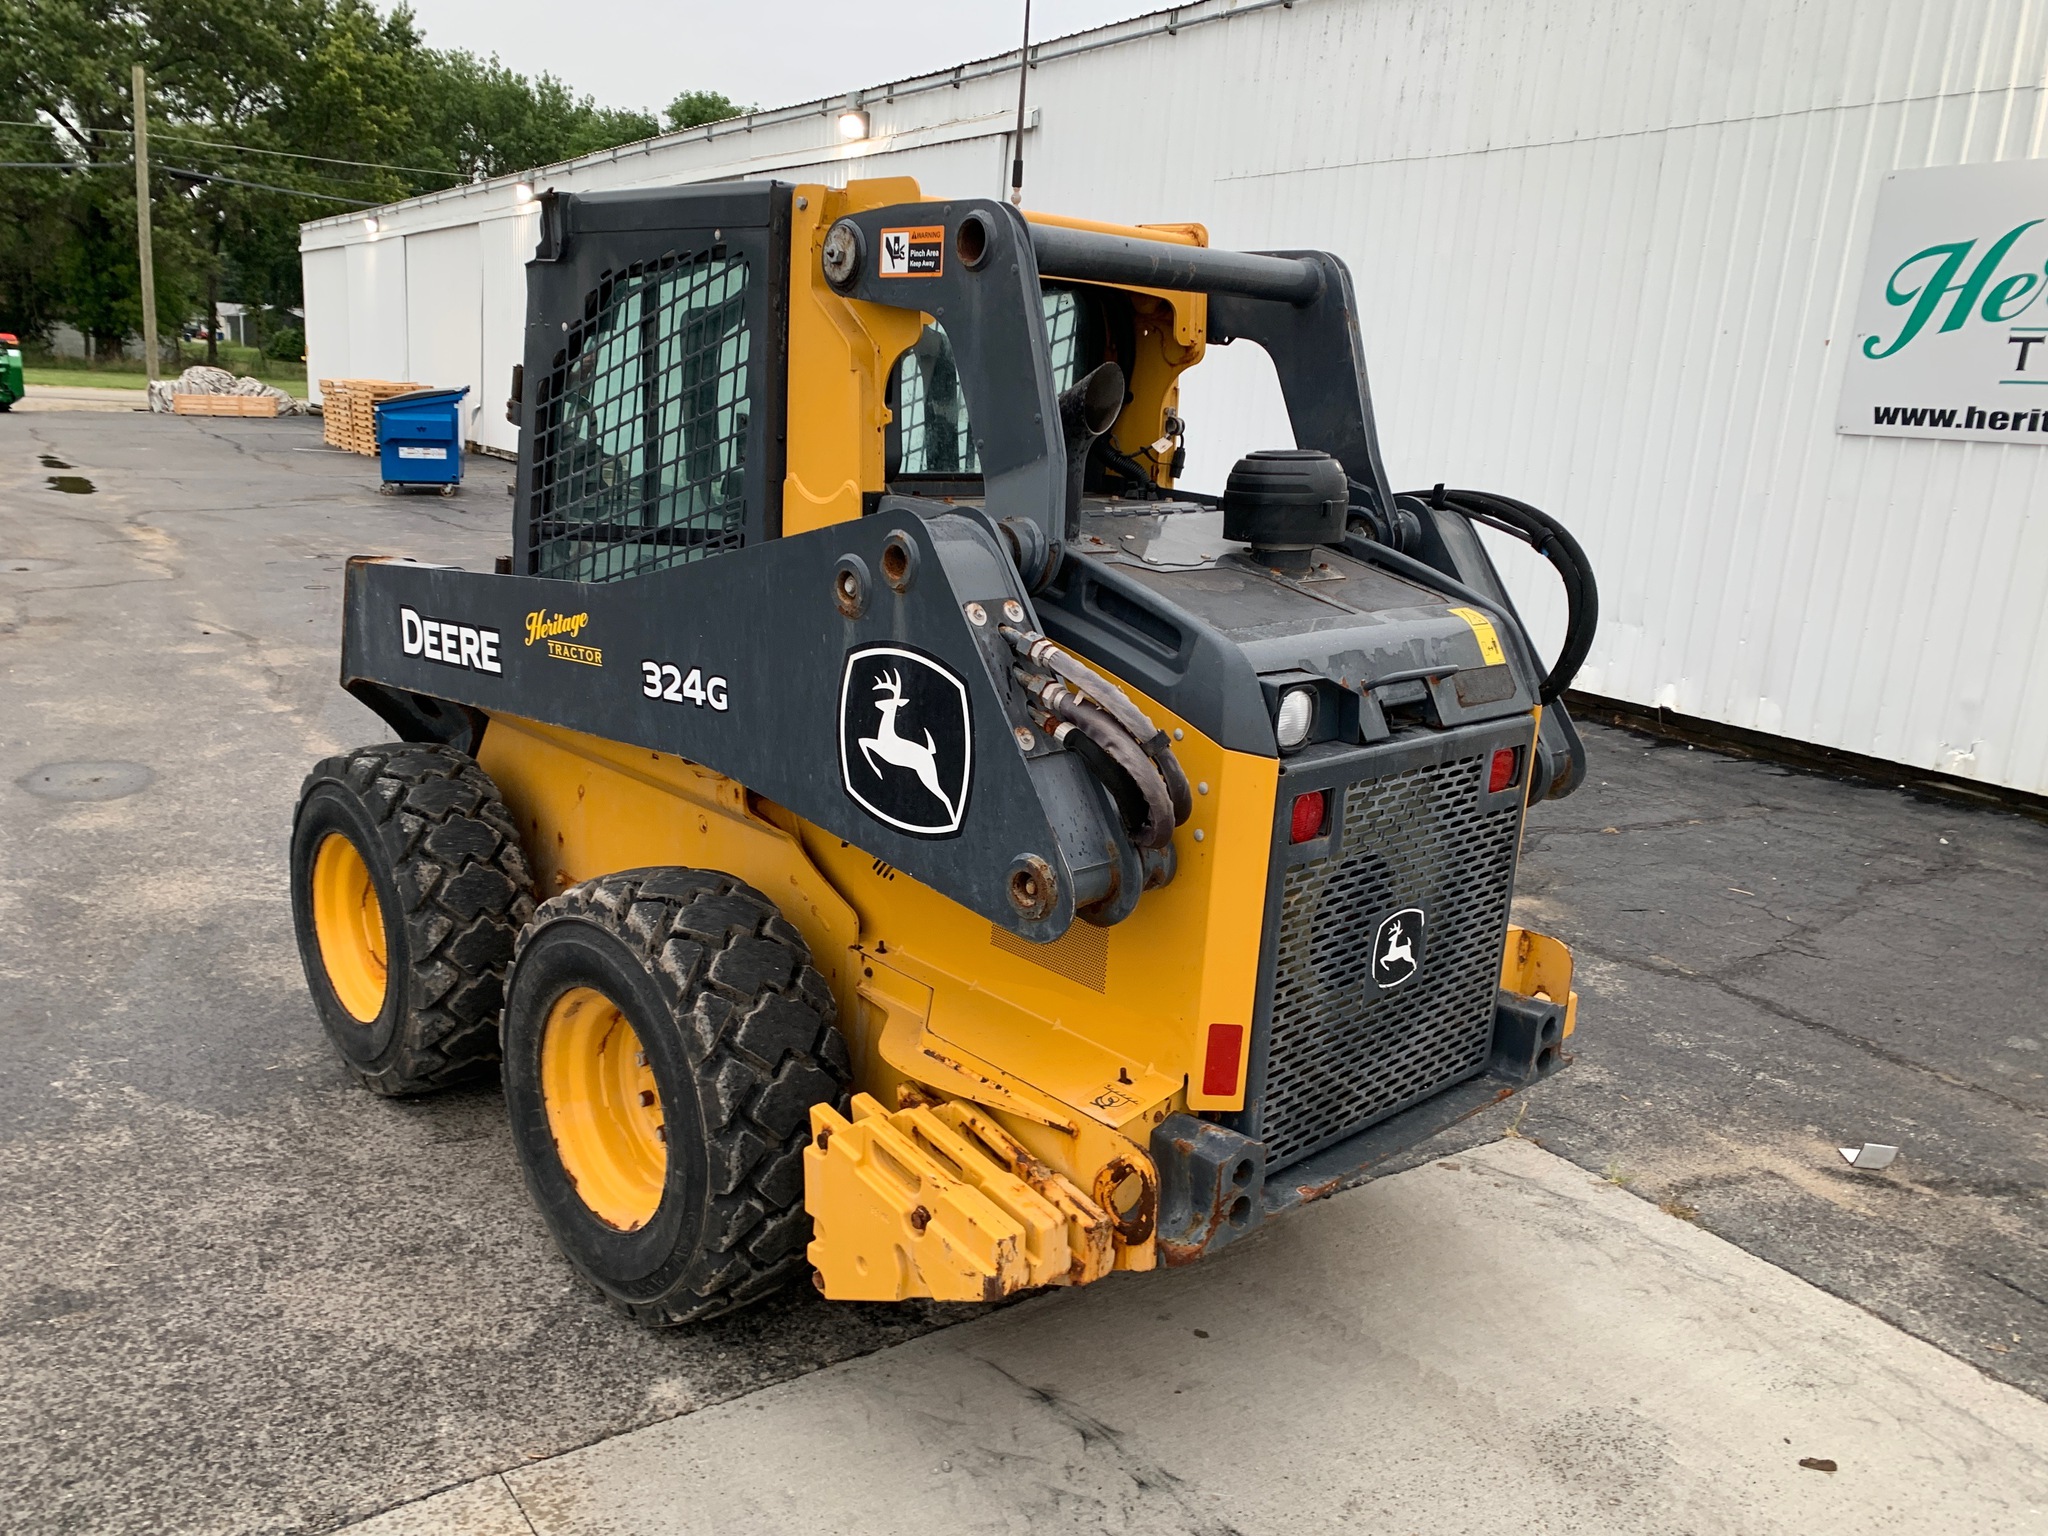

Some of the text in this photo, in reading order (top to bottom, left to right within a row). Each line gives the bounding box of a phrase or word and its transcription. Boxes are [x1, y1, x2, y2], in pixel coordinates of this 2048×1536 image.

[917, 231, 941, 239] WARNING
[910, 249, 939, 257] Pinch Area
[910, 259, 935, 268] Keep Away
[1863, 218, 2048, 360] He
[401, 608, 502, 673] DEERE
[525, 608, 589, 647] Heritage
[549, 642, 603, 664] TRACTOR
[642, 661, 728, 711] 324G
